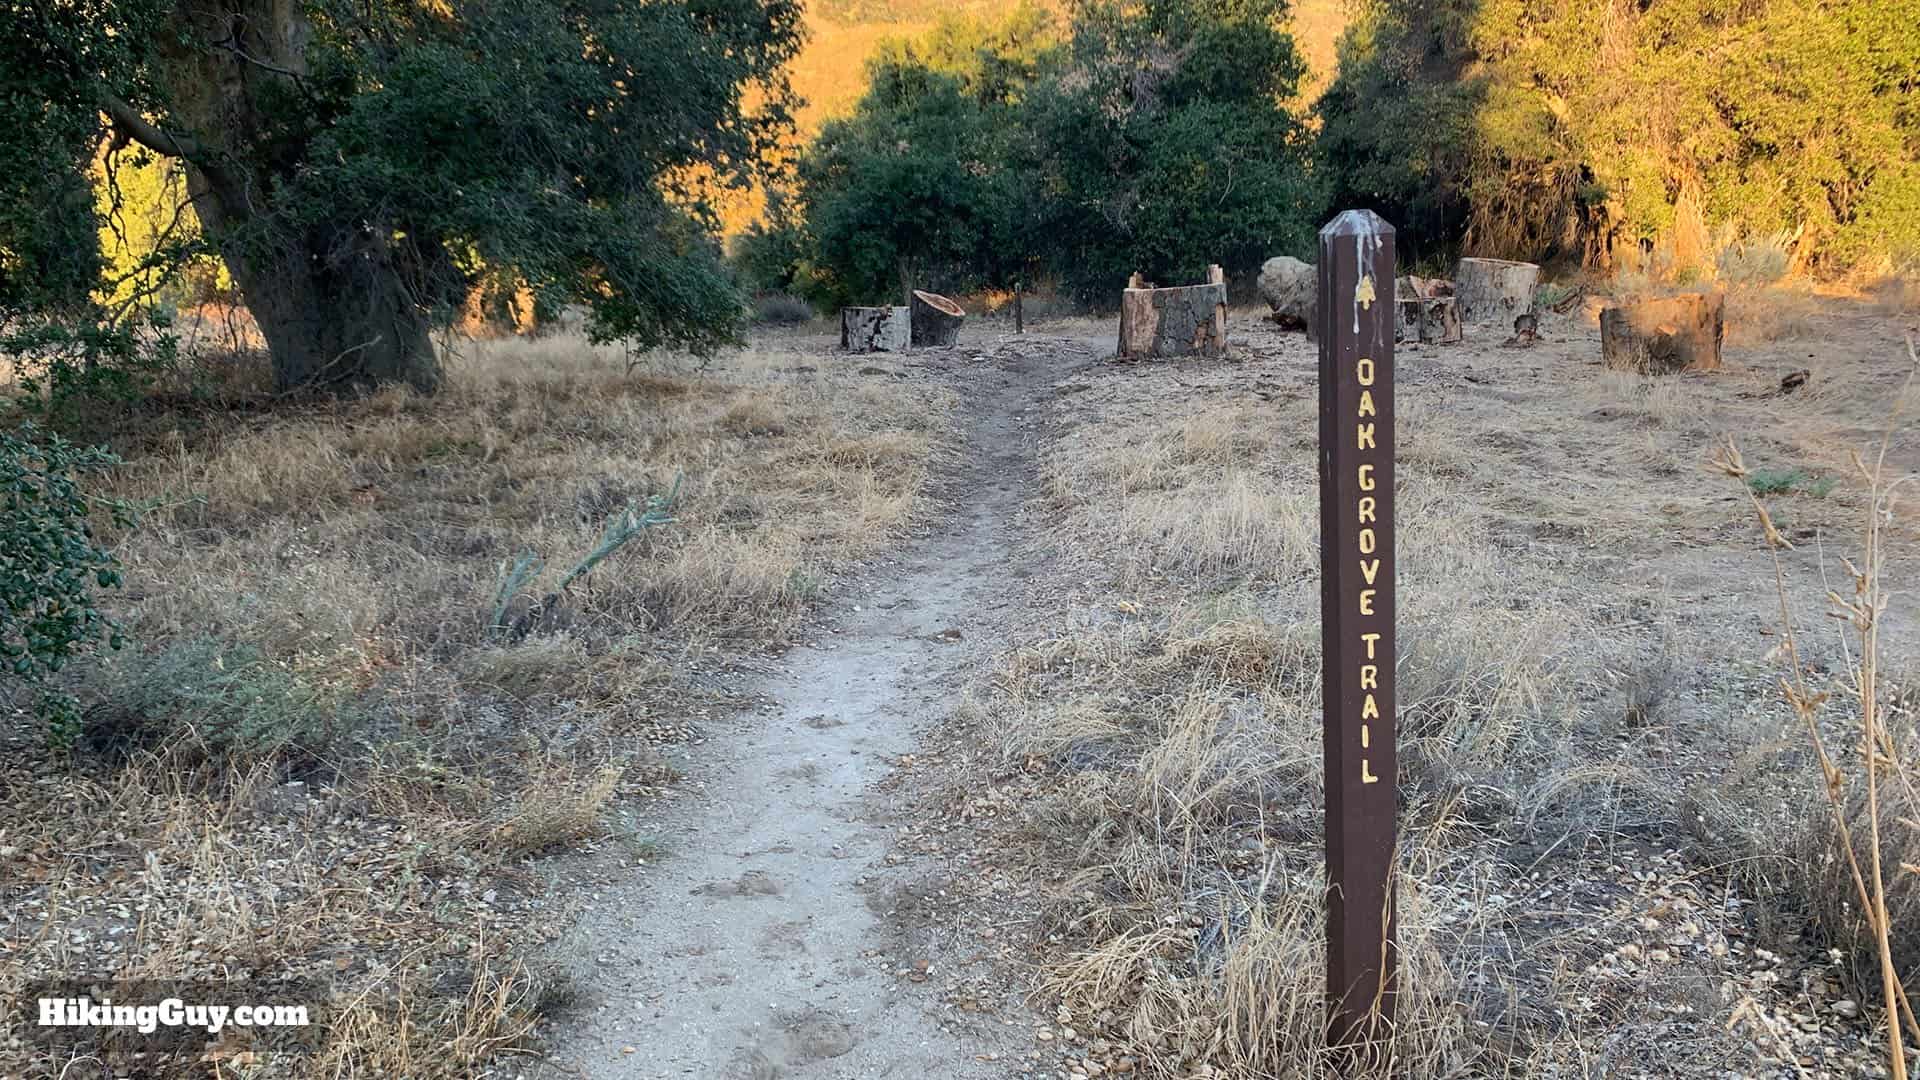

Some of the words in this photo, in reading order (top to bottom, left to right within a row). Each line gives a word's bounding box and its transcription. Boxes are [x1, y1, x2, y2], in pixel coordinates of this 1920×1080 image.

[1357, 358, 1376, 450] OAK
[1358, 464, 1380, 615] GROVE
[1360, 633, 1381, 784] TRAIL
